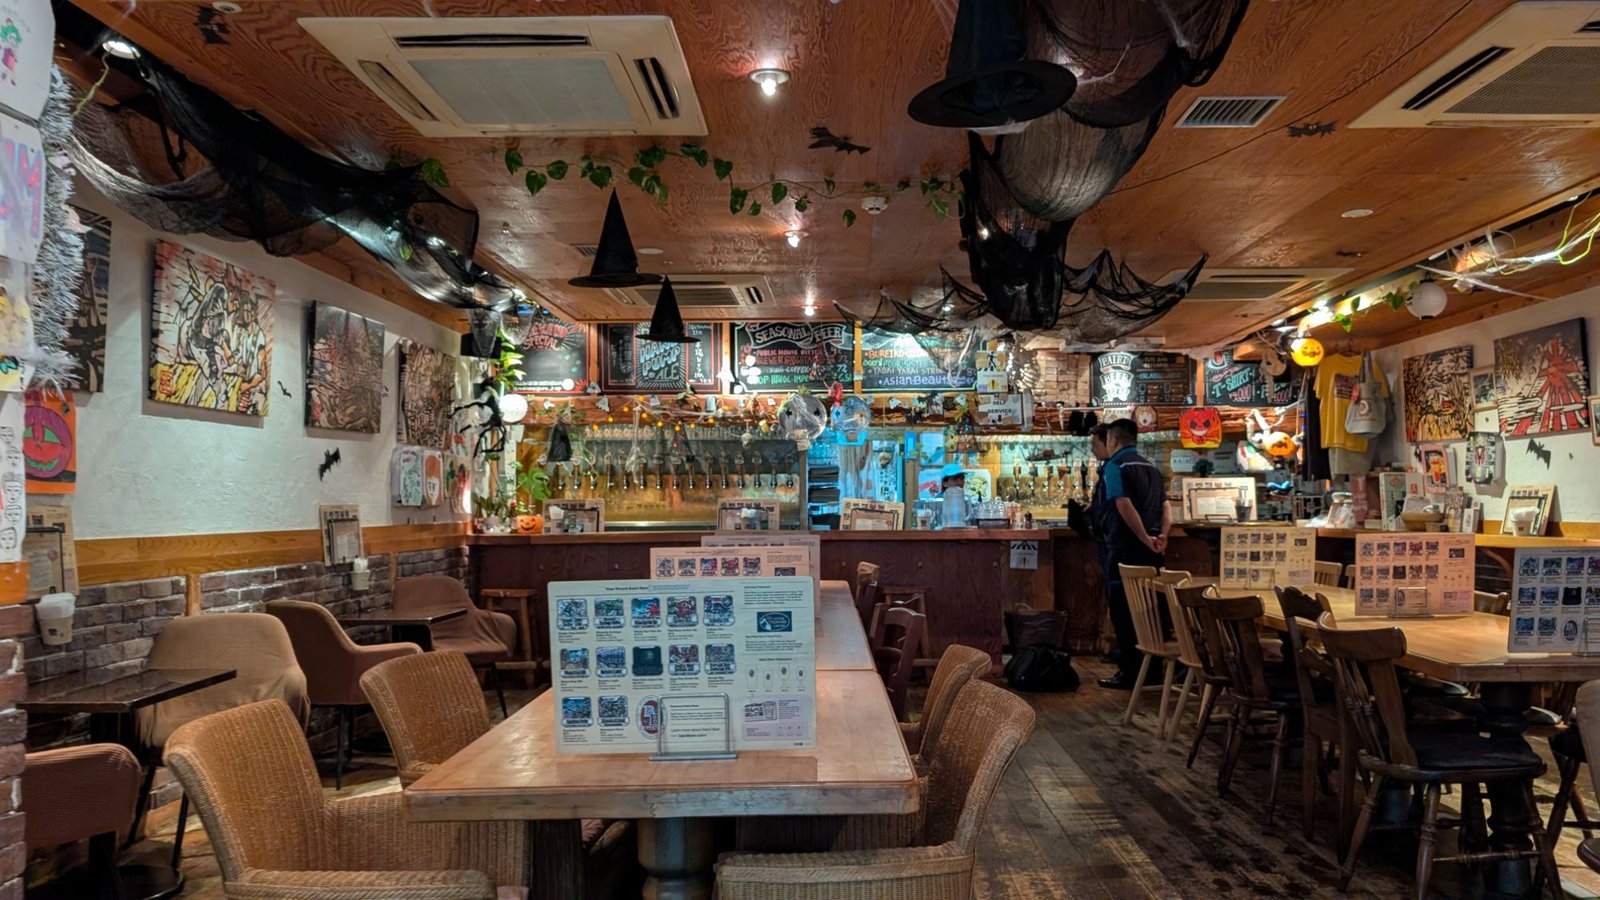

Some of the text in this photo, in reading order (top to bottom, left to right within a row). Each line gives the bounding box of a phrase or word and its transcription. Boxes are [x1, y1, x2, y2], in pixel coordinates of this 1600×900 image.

[523, 335, 560, 351] SPECIAL
[755, 325, 841, 344] SEASONAL BEER
[641, 345, 681, 376] PUMP
[1101, 354, 1130, 366] BAIRD
[656, 362, 680, 380] ALE
[1213, 367, 1252, 398] T-SHIRT
